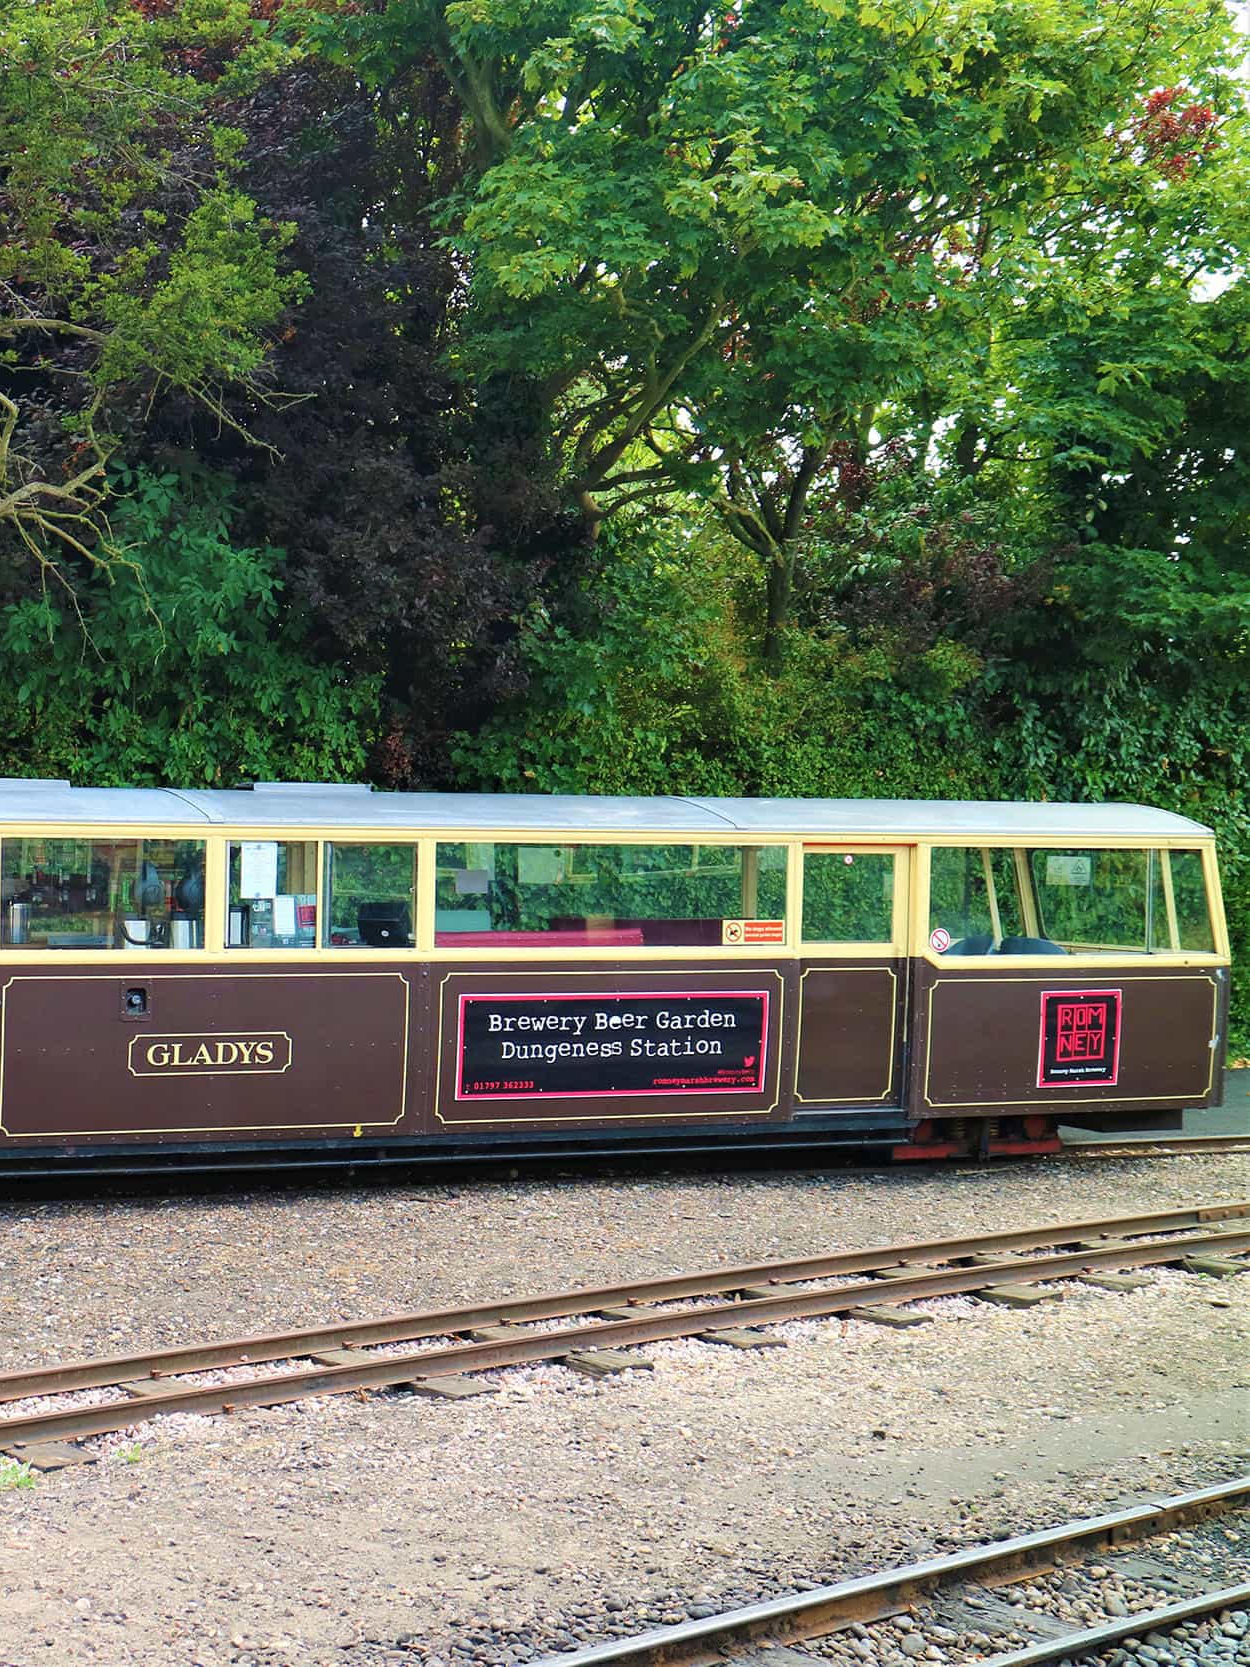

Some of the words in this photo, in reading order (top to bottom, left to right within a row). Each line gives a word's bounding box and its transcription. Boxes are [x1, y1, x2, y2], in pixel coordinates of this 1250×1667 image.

[488, 1013, 587, 1035] Brewery
[595, 1011, 648, 1030] Beer
[656, 1009, 736, 1029] Garden
[1062, 1007, 1102, 1026] ROM
[146, 1041, 274, 1066] GLADYS
[501, 1041, 623, 1064] Dungeness
[630, 1035, 722, 1057] Station
[1060, 1033, 1102, 1053] NEY
